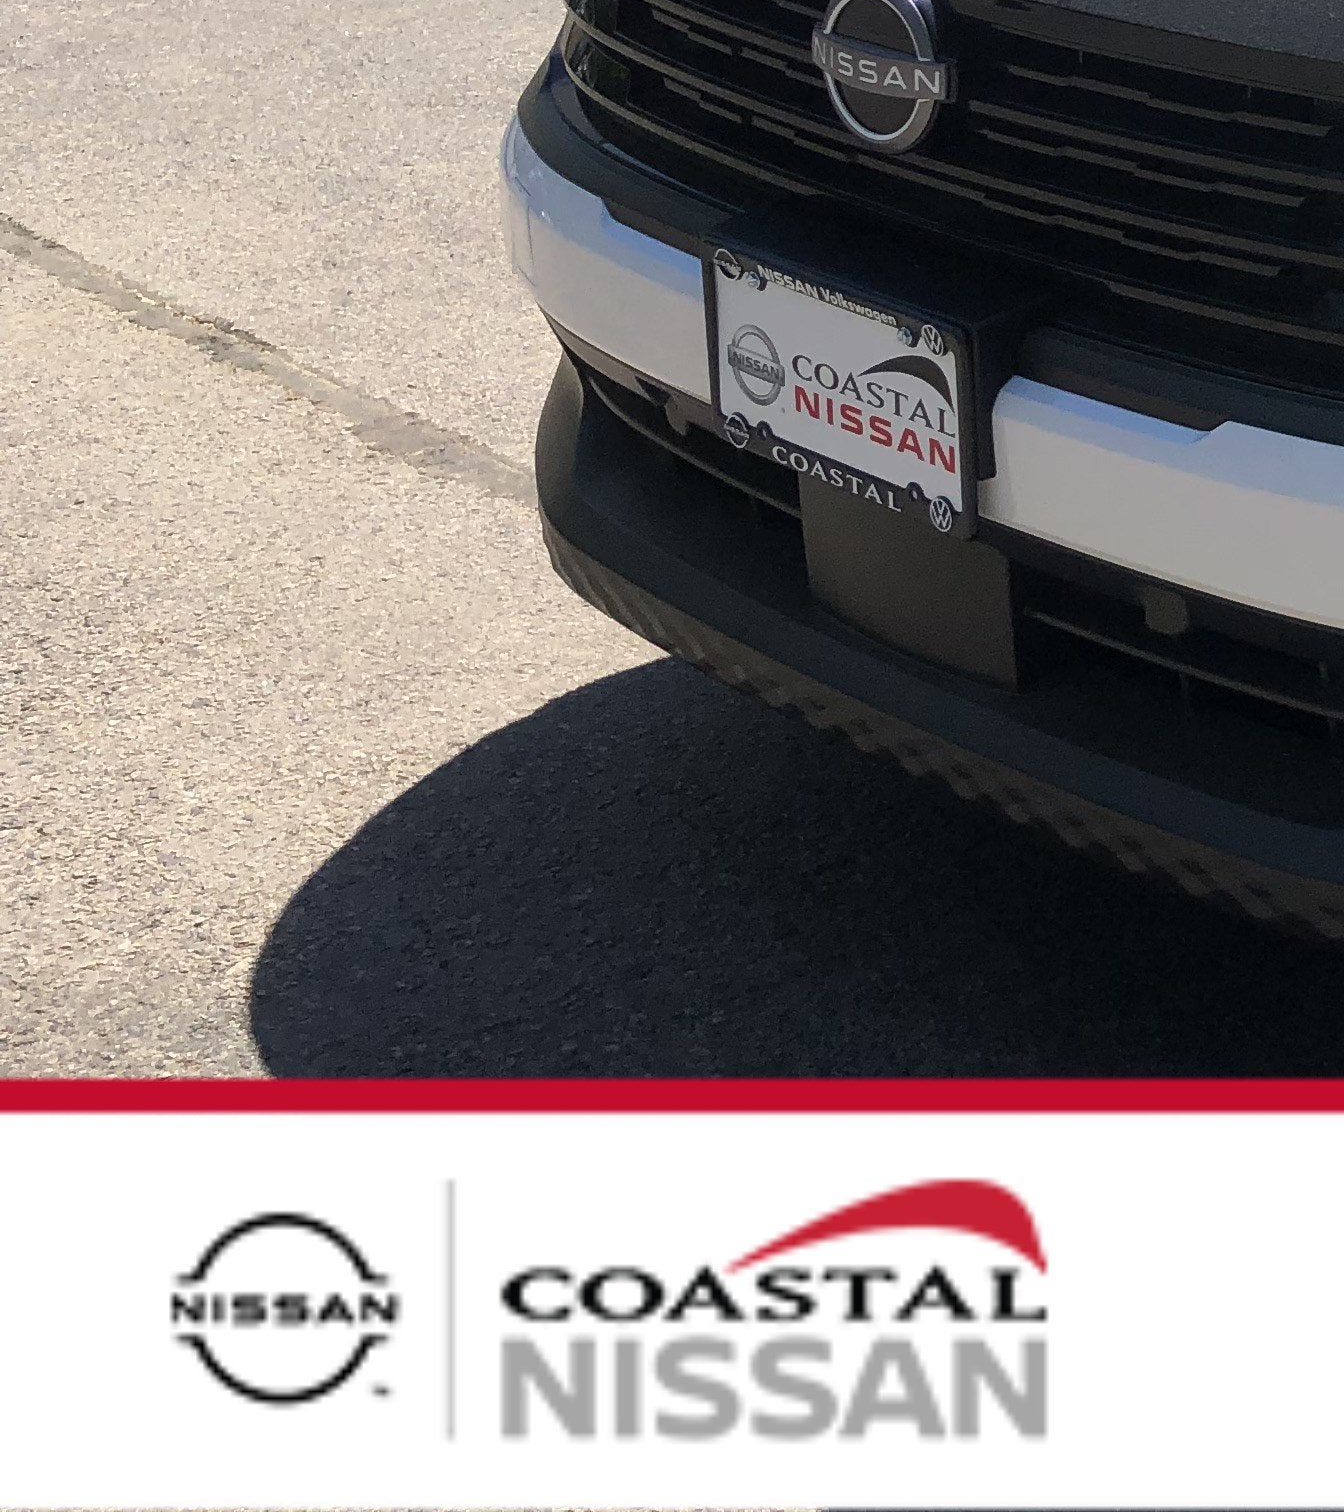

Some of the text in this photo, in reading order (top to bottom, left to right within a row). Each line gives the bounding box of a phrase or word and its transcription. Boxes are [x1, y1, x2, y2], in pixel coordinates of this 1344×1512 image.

[813, 37, 941, 94] NISSAN
[757, 264, 819, 299] NISSAN
[819, 286, 897, 326] Volkswagen
[732, 350, 780, 380] NISSAN
[791, 355, 956, 438] COASTAL
[794, 385, 956, 474] NISSAN
[771, 445, 902, 513] COASTAL
